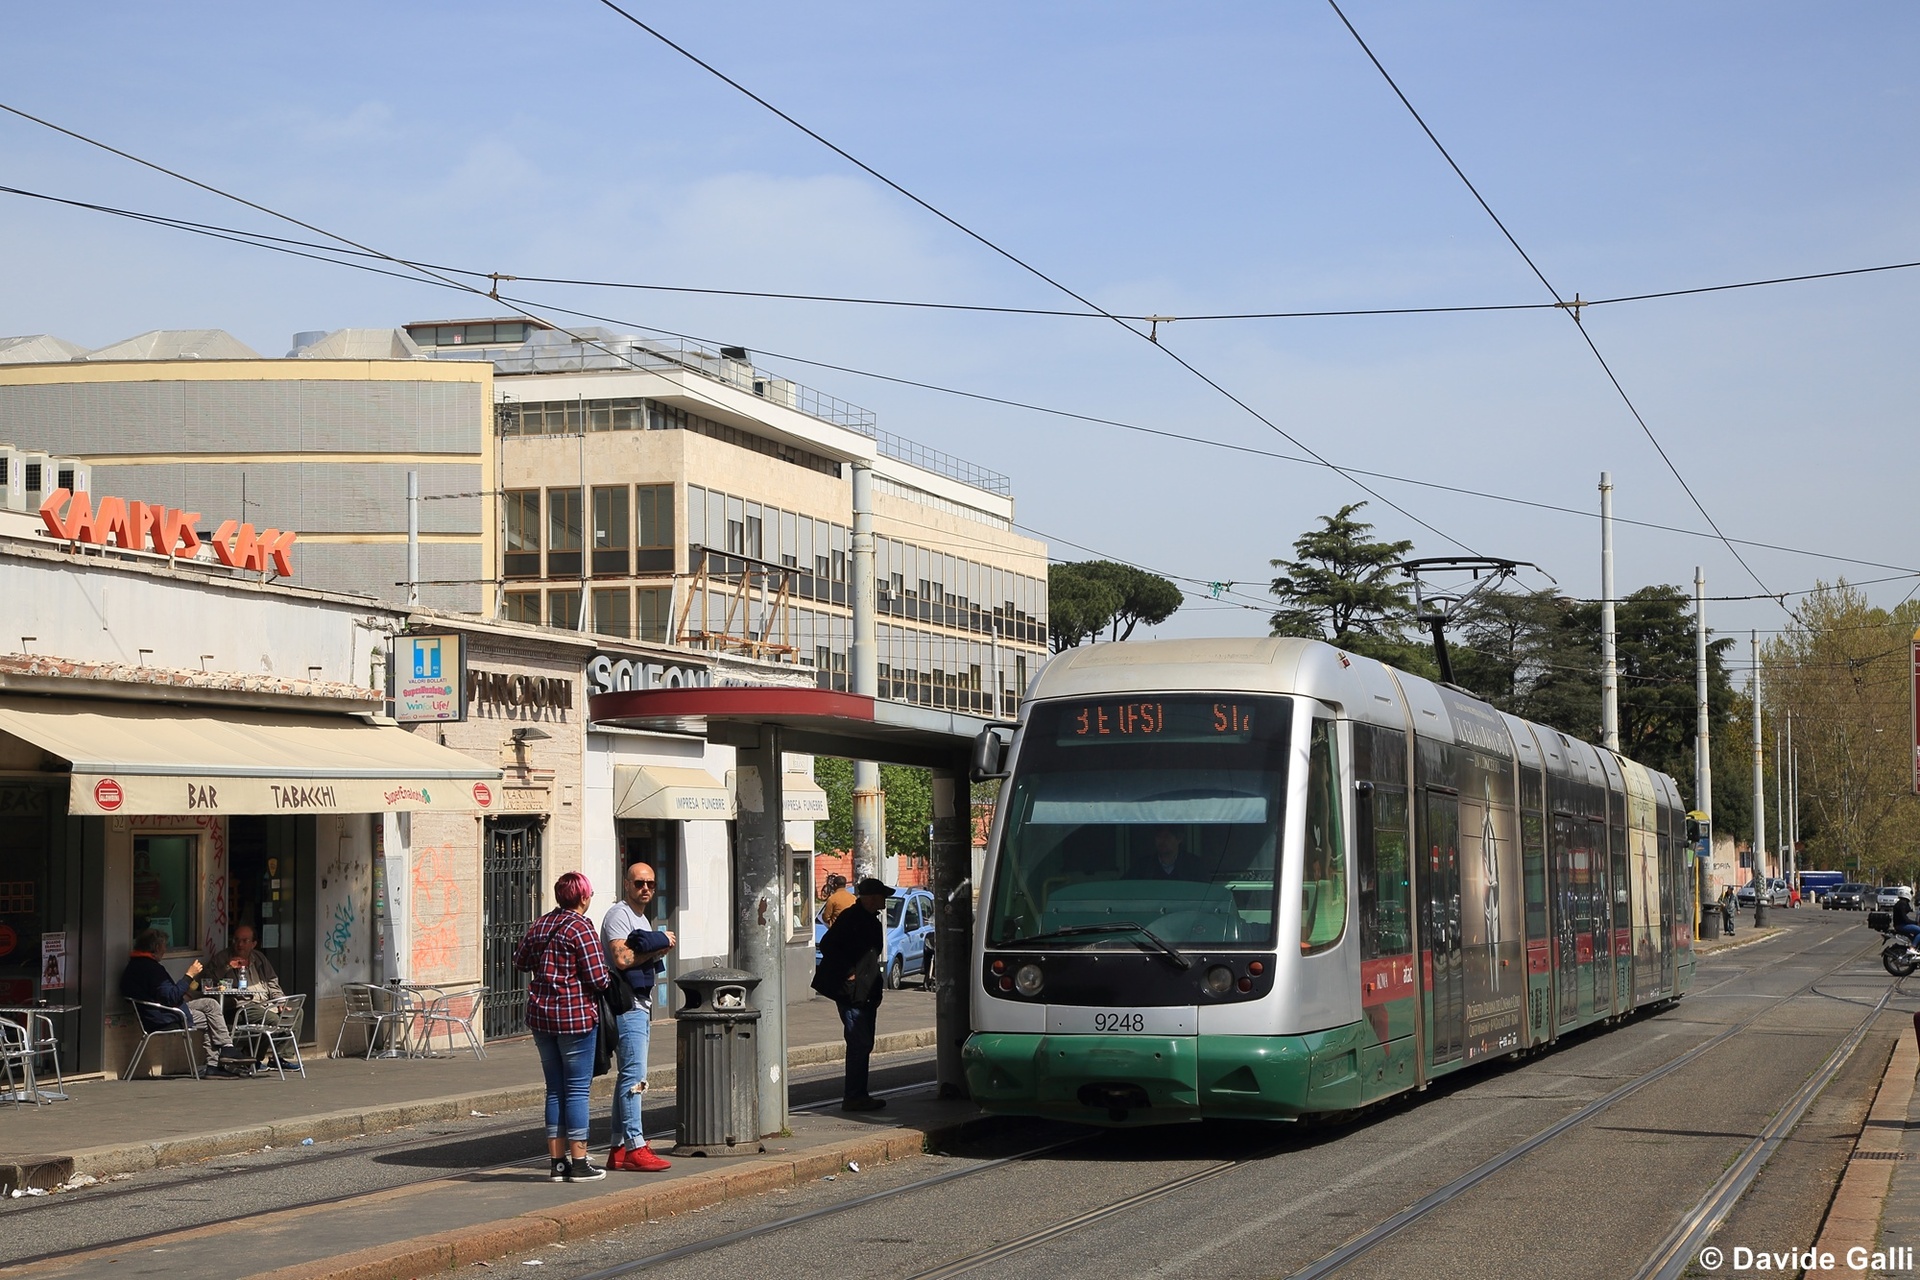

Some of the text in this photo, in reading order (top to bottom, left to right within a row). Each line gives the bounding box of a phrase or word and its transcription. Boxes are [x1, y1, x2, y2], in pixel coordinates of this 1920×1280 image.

[39, 488, 201, 558] CAMPUS
[588, 655, 714, 695] SCIFONI
[188, 783, 337, 809] BAR TABACCHI
[675, 797, 725, 811] IMPRESA FUNEBRE
[803, 800, 824, 812] FUNEBRE
[1095, 1012, 1144, 1032] 9248
